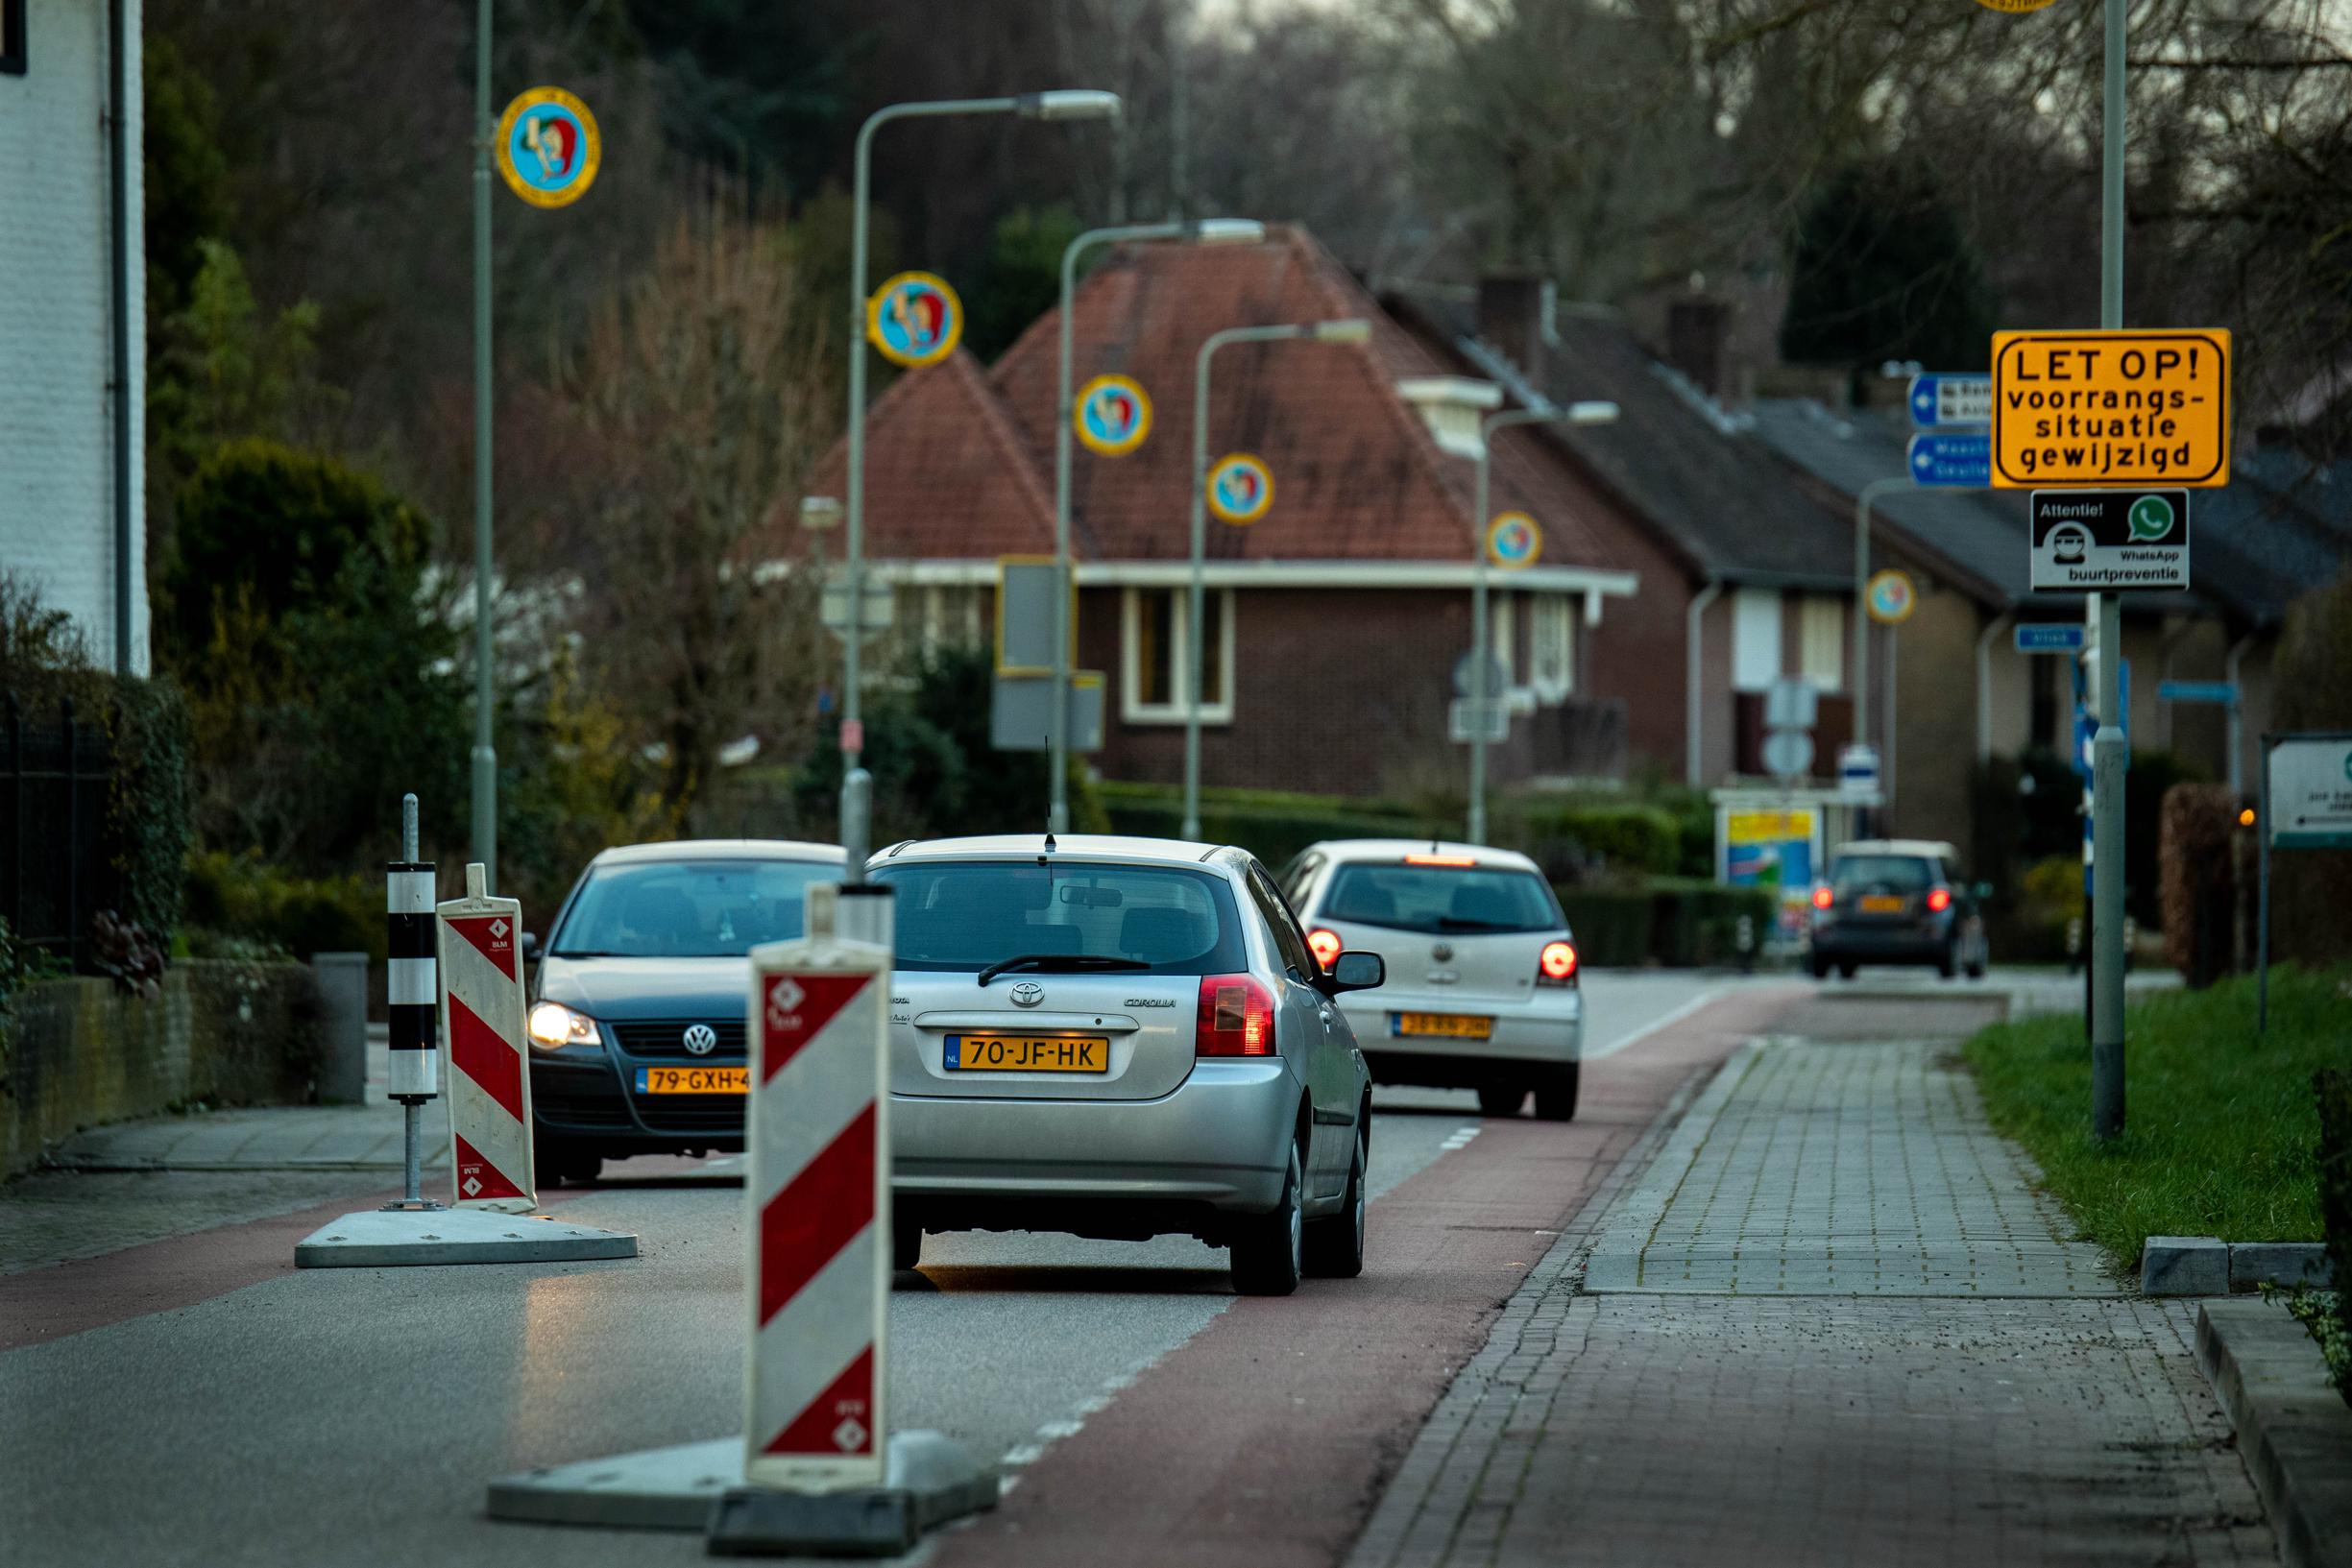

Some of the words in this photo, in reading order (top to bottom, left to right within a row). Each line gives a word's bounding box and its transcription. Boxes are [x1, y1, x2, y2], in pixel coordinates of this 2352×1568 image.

[2016, 350, 2100, 380] LET
[2120, 349, 2198, 380] OP!
[2007, 389, 2205, 416] voorrangs-
[2035, 414, 2176, 438] situatie
[2020, 442, 2190, 474] gewijzigd
[2040, 502, 2103, 519] Attentie!
[2121, 550, 2179, 563] WhatsApp
[2069, 567, 2179, 583] buurtpreventie
[1124, 999, 1176, 1007] COROLLA
[970, 1041, 1095, 1067] 70-JF-HK
